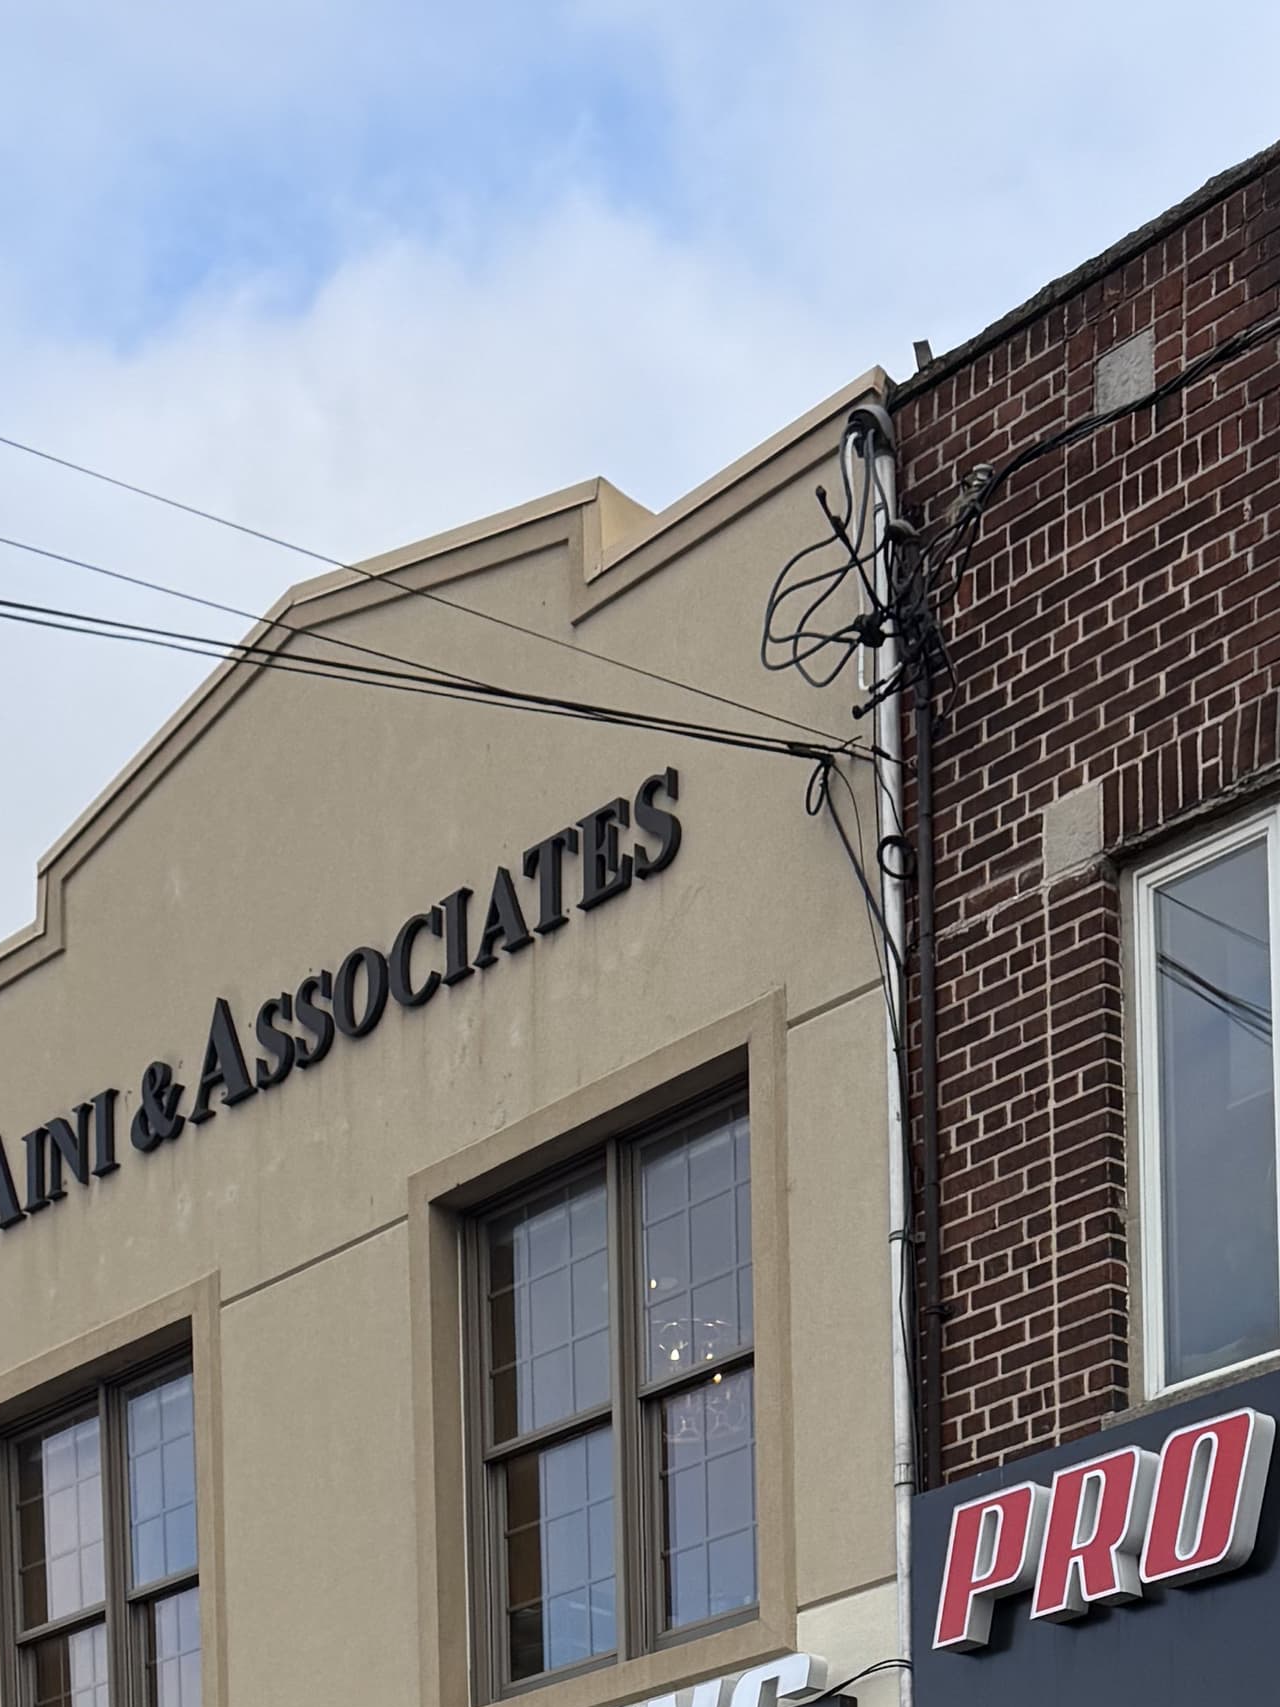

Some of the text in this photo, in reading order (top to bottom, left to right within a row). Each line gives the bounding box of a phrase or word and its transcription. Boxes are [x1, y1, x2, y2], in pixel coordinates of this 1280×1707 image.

[130, 1061, 185, 1152] &
[188, 767, 682, 1125] ASSOCIATES
[931, 1406, 1276, 1653] PRO
